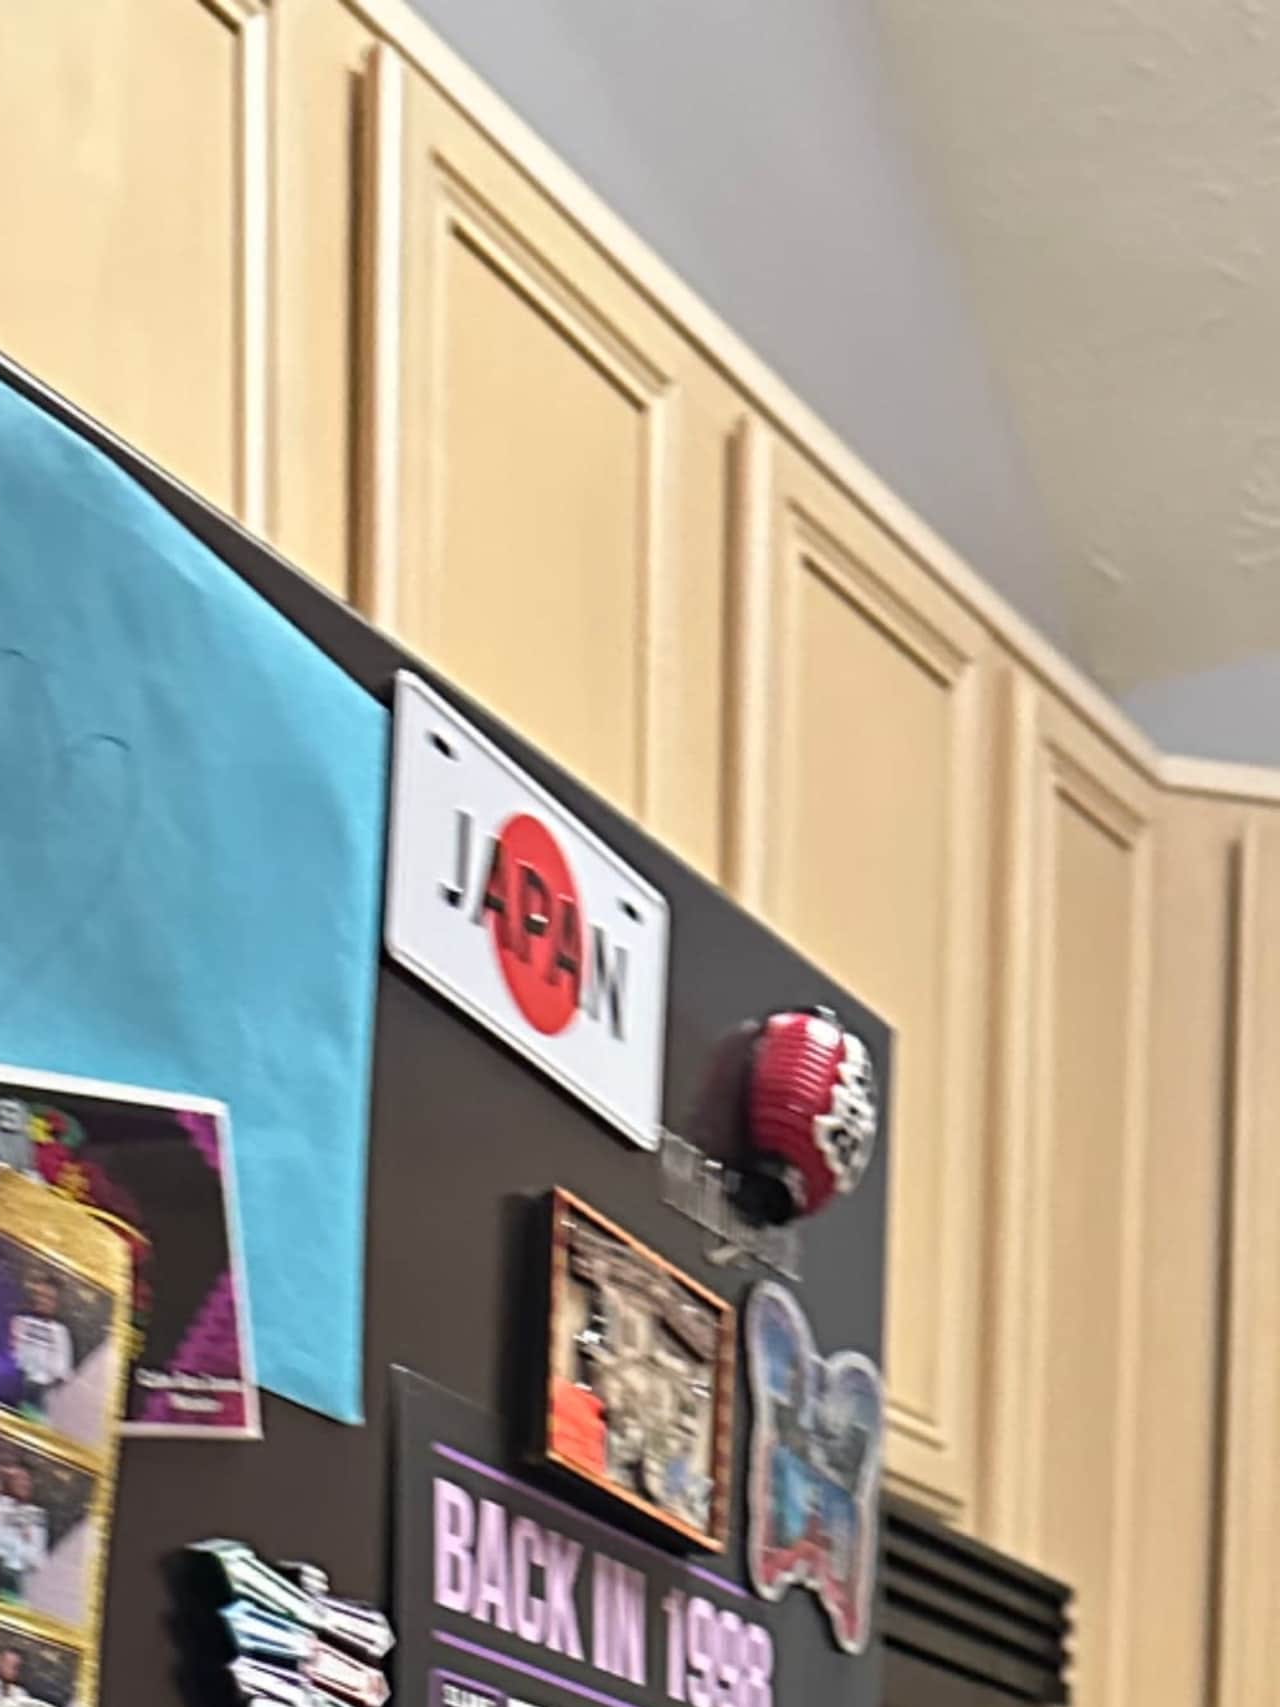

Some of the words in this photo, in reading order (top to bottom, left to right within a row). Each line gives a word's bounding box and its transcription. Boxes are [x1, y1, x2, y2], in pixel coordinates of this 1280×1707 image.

[437, 808, 630, 1042] JAPAN
[433, 1477, 584, 1662] BACK
[591, 1552, 647, 1687] IN
